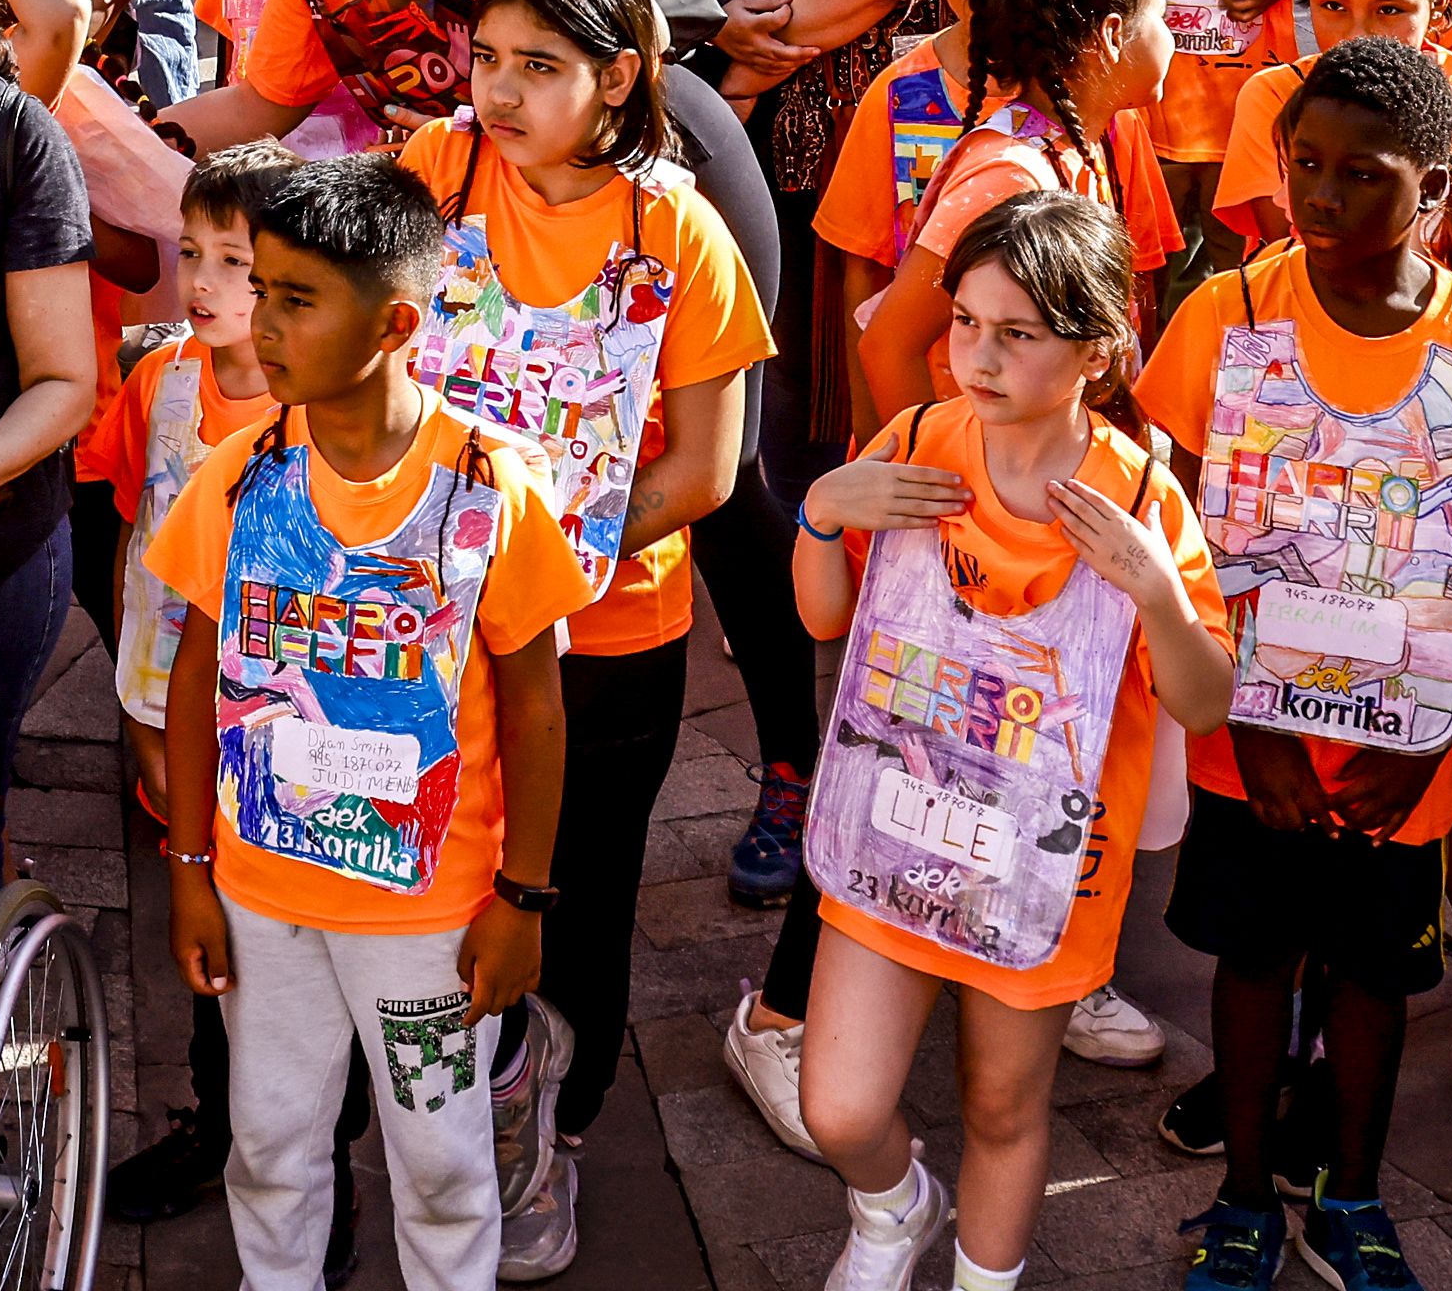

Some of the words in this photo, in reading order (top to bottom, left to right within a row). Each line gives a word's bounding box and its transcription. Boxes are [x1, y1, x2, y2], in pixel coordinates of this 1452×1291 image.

[1230, 449, 1421, 518] HARRO
[240, 580, 427, 643] HARRO
[866, 629, 1044, 727] HARRO
[1296, 657, 1360, 698] aek
[1281, 682, 1403, 738] korrika
[315, 799, 372, 833] aek
